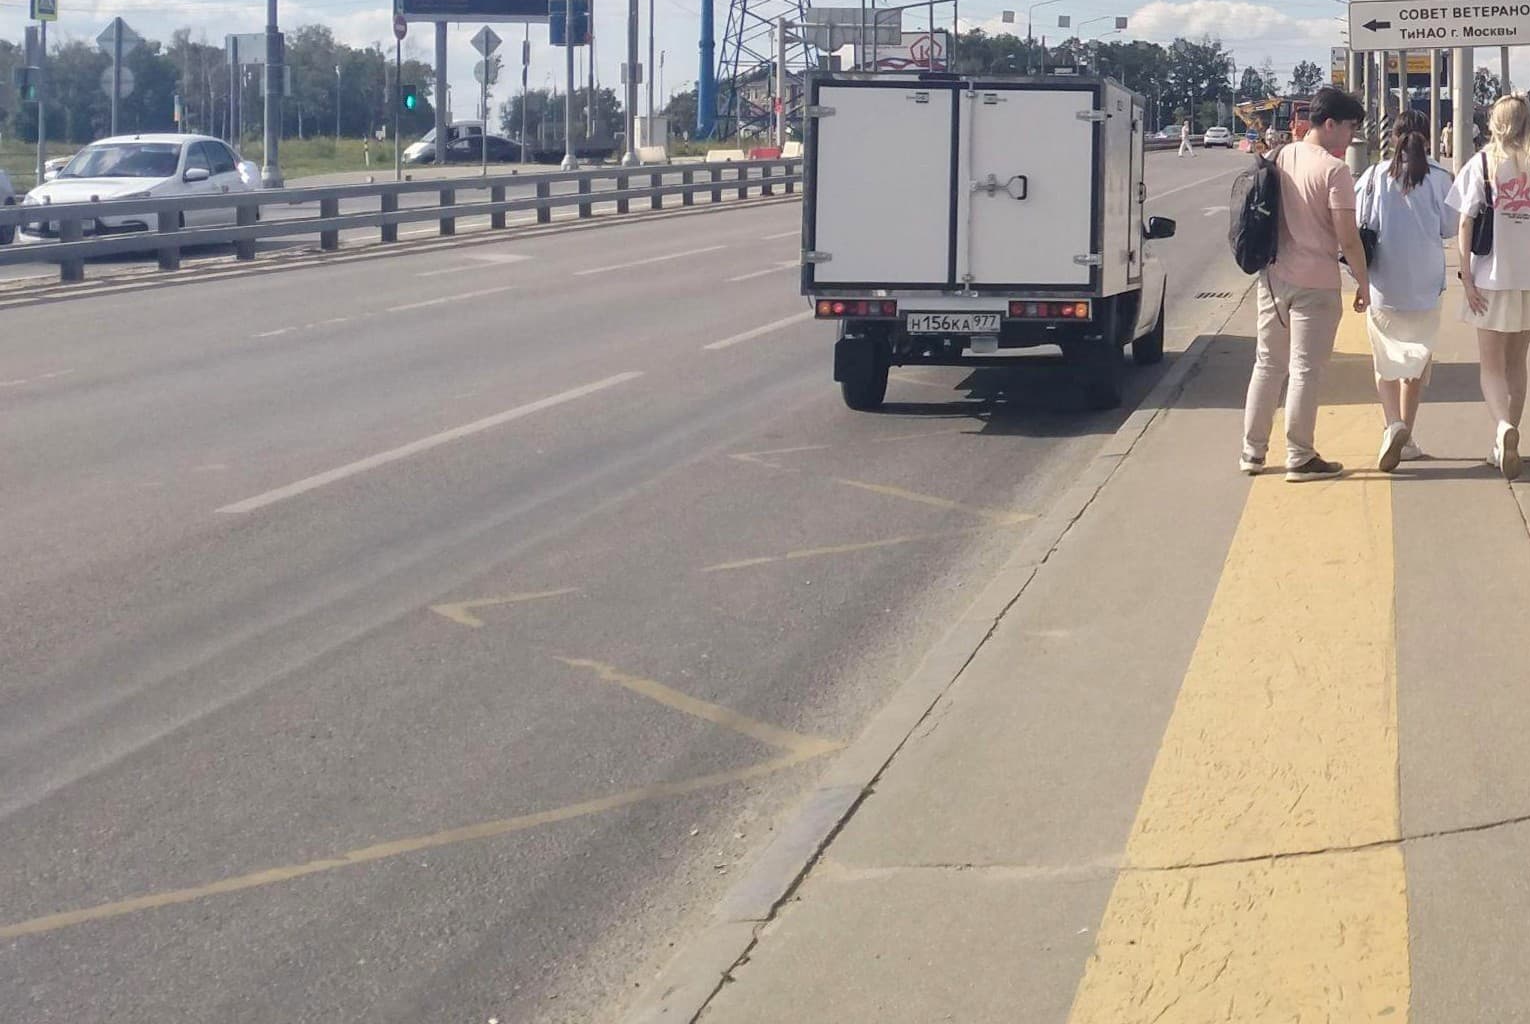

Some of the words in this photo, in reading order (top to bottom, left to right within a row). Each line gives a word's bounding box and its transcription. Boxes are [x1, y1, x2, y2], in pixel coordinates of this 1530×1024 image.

[1399, 7, 1448, 20] СОВЕТ
[1400, 27, 1446, 39] ТиНАО
[1451, 28, 1459, 37] г.
[1463, 26, 1517, 37] Москвы
[911, 315, 970, 330] Н156КА
[974, 315, 996, 326] 977
